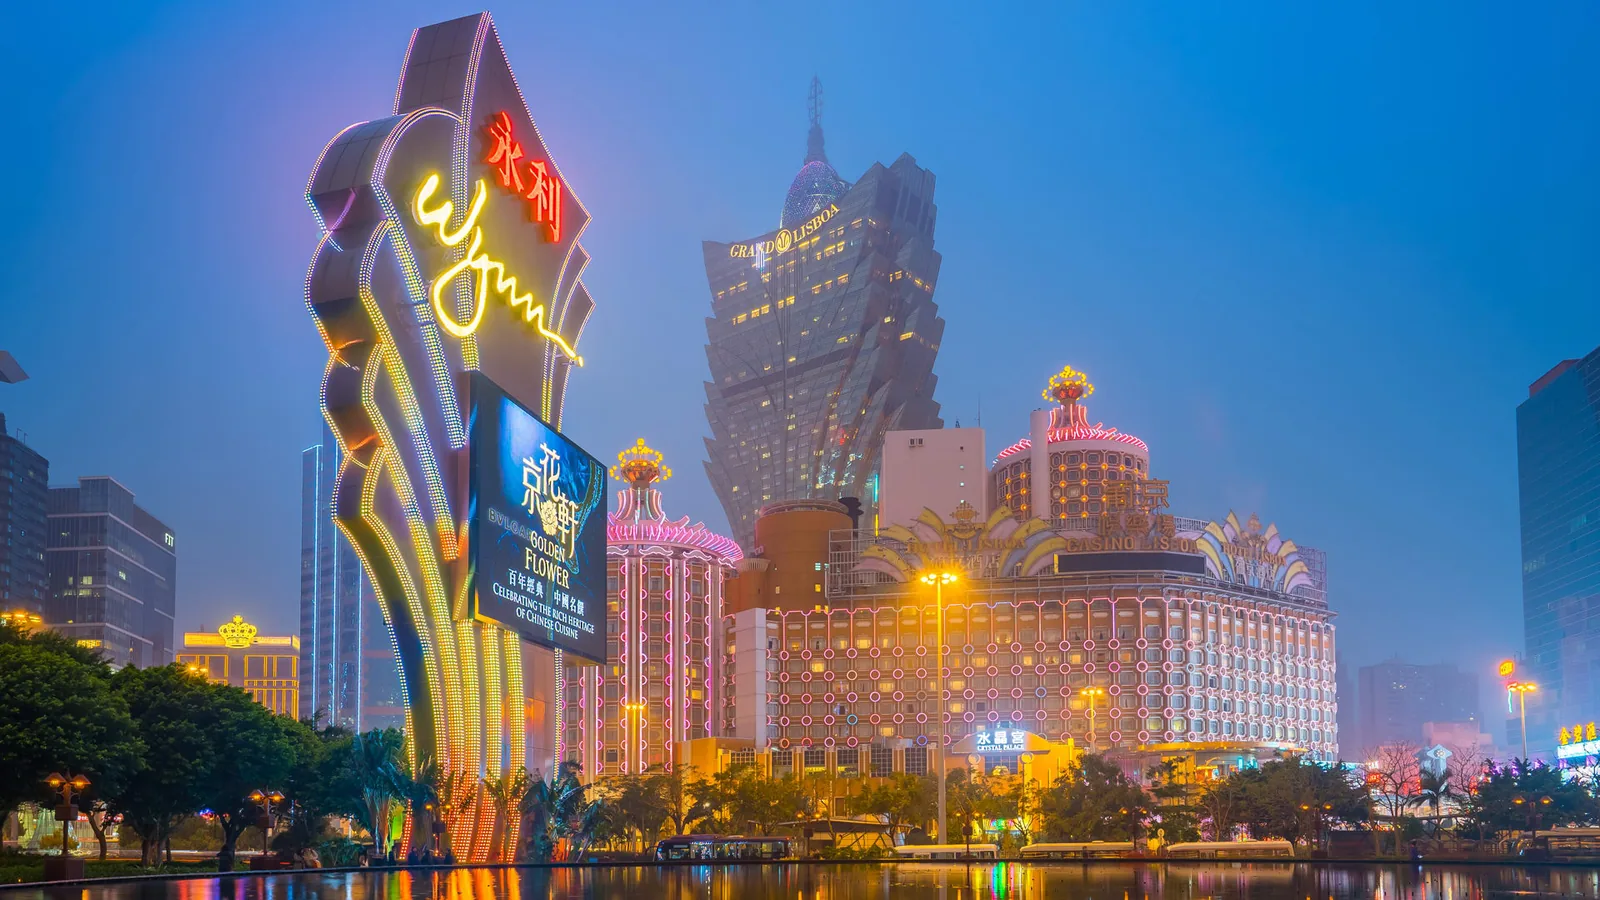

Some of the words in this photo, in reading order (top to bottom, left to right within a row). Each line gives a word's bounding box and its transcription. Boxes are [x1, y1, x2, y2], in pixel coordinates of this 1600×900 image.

[488, 111, 563, 243] 永利
[730, 240, 775, 258] GRAND
[793, 203, 841, 243] LISBOA
[530, 530, 566, 563] GOLDEN
[1066, 536, 1135, 552] CASINO
[524, 546, 570, 590] FLOWER
[492, 582, 538, 611] CELEBRATING
[539, 602, 552, 617] THE
[552, 608, 569, 624] RICH
[568, 615, 595, 634] HERITAGE
[516, 606, 526, 620] OF
[526, 608, 554, 630] CHINESE
[554, 620, 579, 640] CUISINE
[977, 731, 1024, 744] 水晶宮
